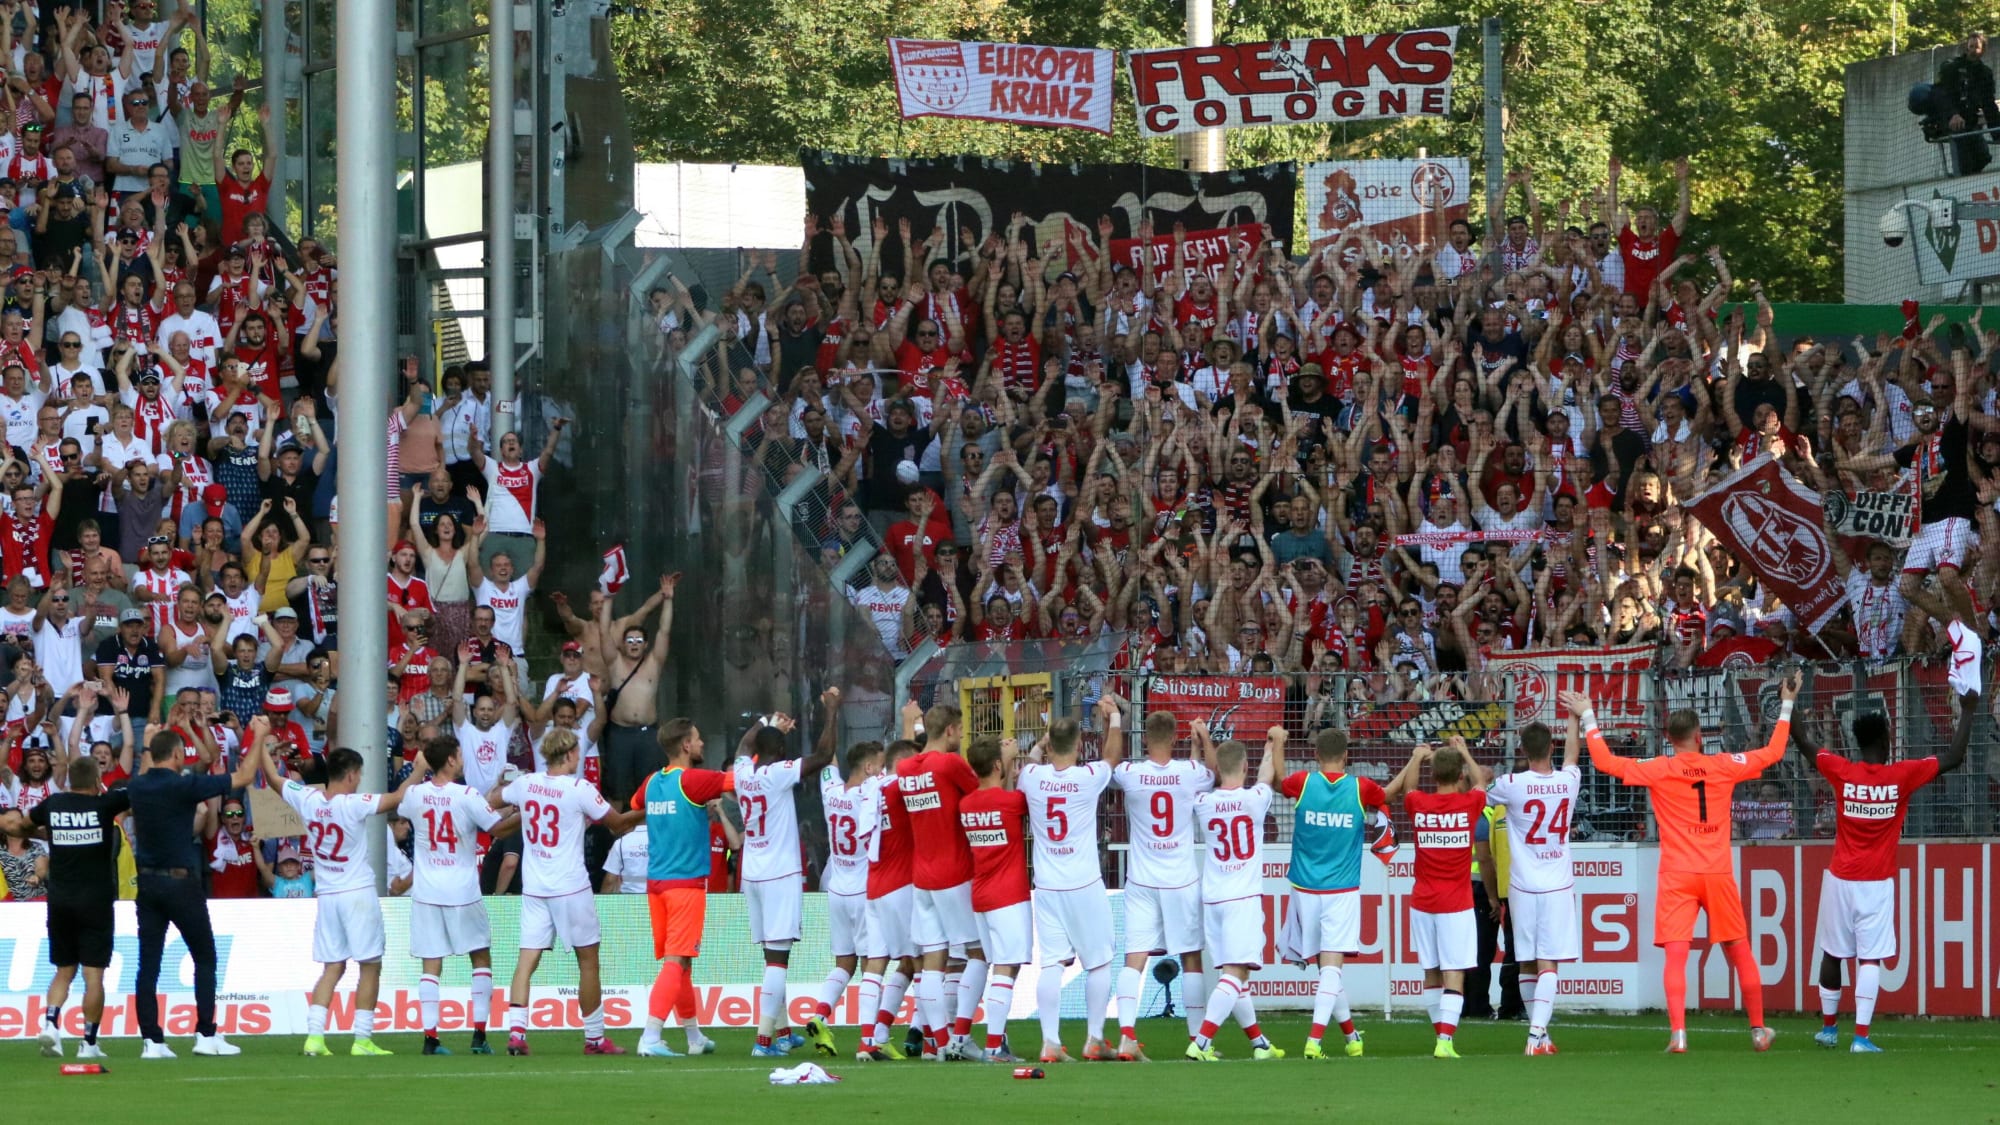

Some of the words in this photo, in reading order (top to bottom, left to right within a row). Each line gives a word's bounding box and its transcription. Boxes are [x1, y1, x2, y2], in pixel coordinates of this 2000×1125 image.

[978, 44, 1095, 84] EUROPA
[1130, 31, 1454, 106] FREAKS
[989, 79, 1094, 121] KRANZ
[1145, 88, 1445, 133] COLOGNE
[122, 133, 131, 143] 5
[189, 129, 218, 142] REWE
[1364, 182, 1402, 199] Die
[497, 476, 529, 487] REWE
[870, 602, 902, 612] REWE
[233, 676, 261, 688] REWE
[1139, 774, 1181, 786] TERODDE
[1682, 768, 1707, 777] HORN
[898, 771, 935, 792] REWE
[1039, 780, 1080, 793] CZICHOS
[1527, 783, 1569, 795] DREXLER
[527, 783, 565, 799] BORNAUW
[1843, 782, 1899, 800] REWE
[647, 800, 677, 815] REWE
[906, 793, 938, 810] hlsport
[1215, 801, 1243, 812] KAINZ
[1691, 780, 1708, 824] 1
[1845, 802, 1896, 818] uhlsport
[50, 811, 100, 827] REWE
[740, 794, 768, 837] 27
[961, 811, 1004, 827] REWE
[1046, 797, 1068, 842] 5
[1150, 790, 1174, 838] 9
[1304, 810, 1353, 828] REWE
[1414, 812, 1469, 829] REWE
[1523, 798, 1570, 845] 24
[422, 808, 459, 854] 14
[524, 799, 560, 848] 33
[54, 829, 101, 843] uhlsport
[308, 821, 349, 863] 22
[828, 813, 857, 856] 13
[1207, 815, 1256, 862] 30
[1418, 832, 1468, 848] uhlsport
